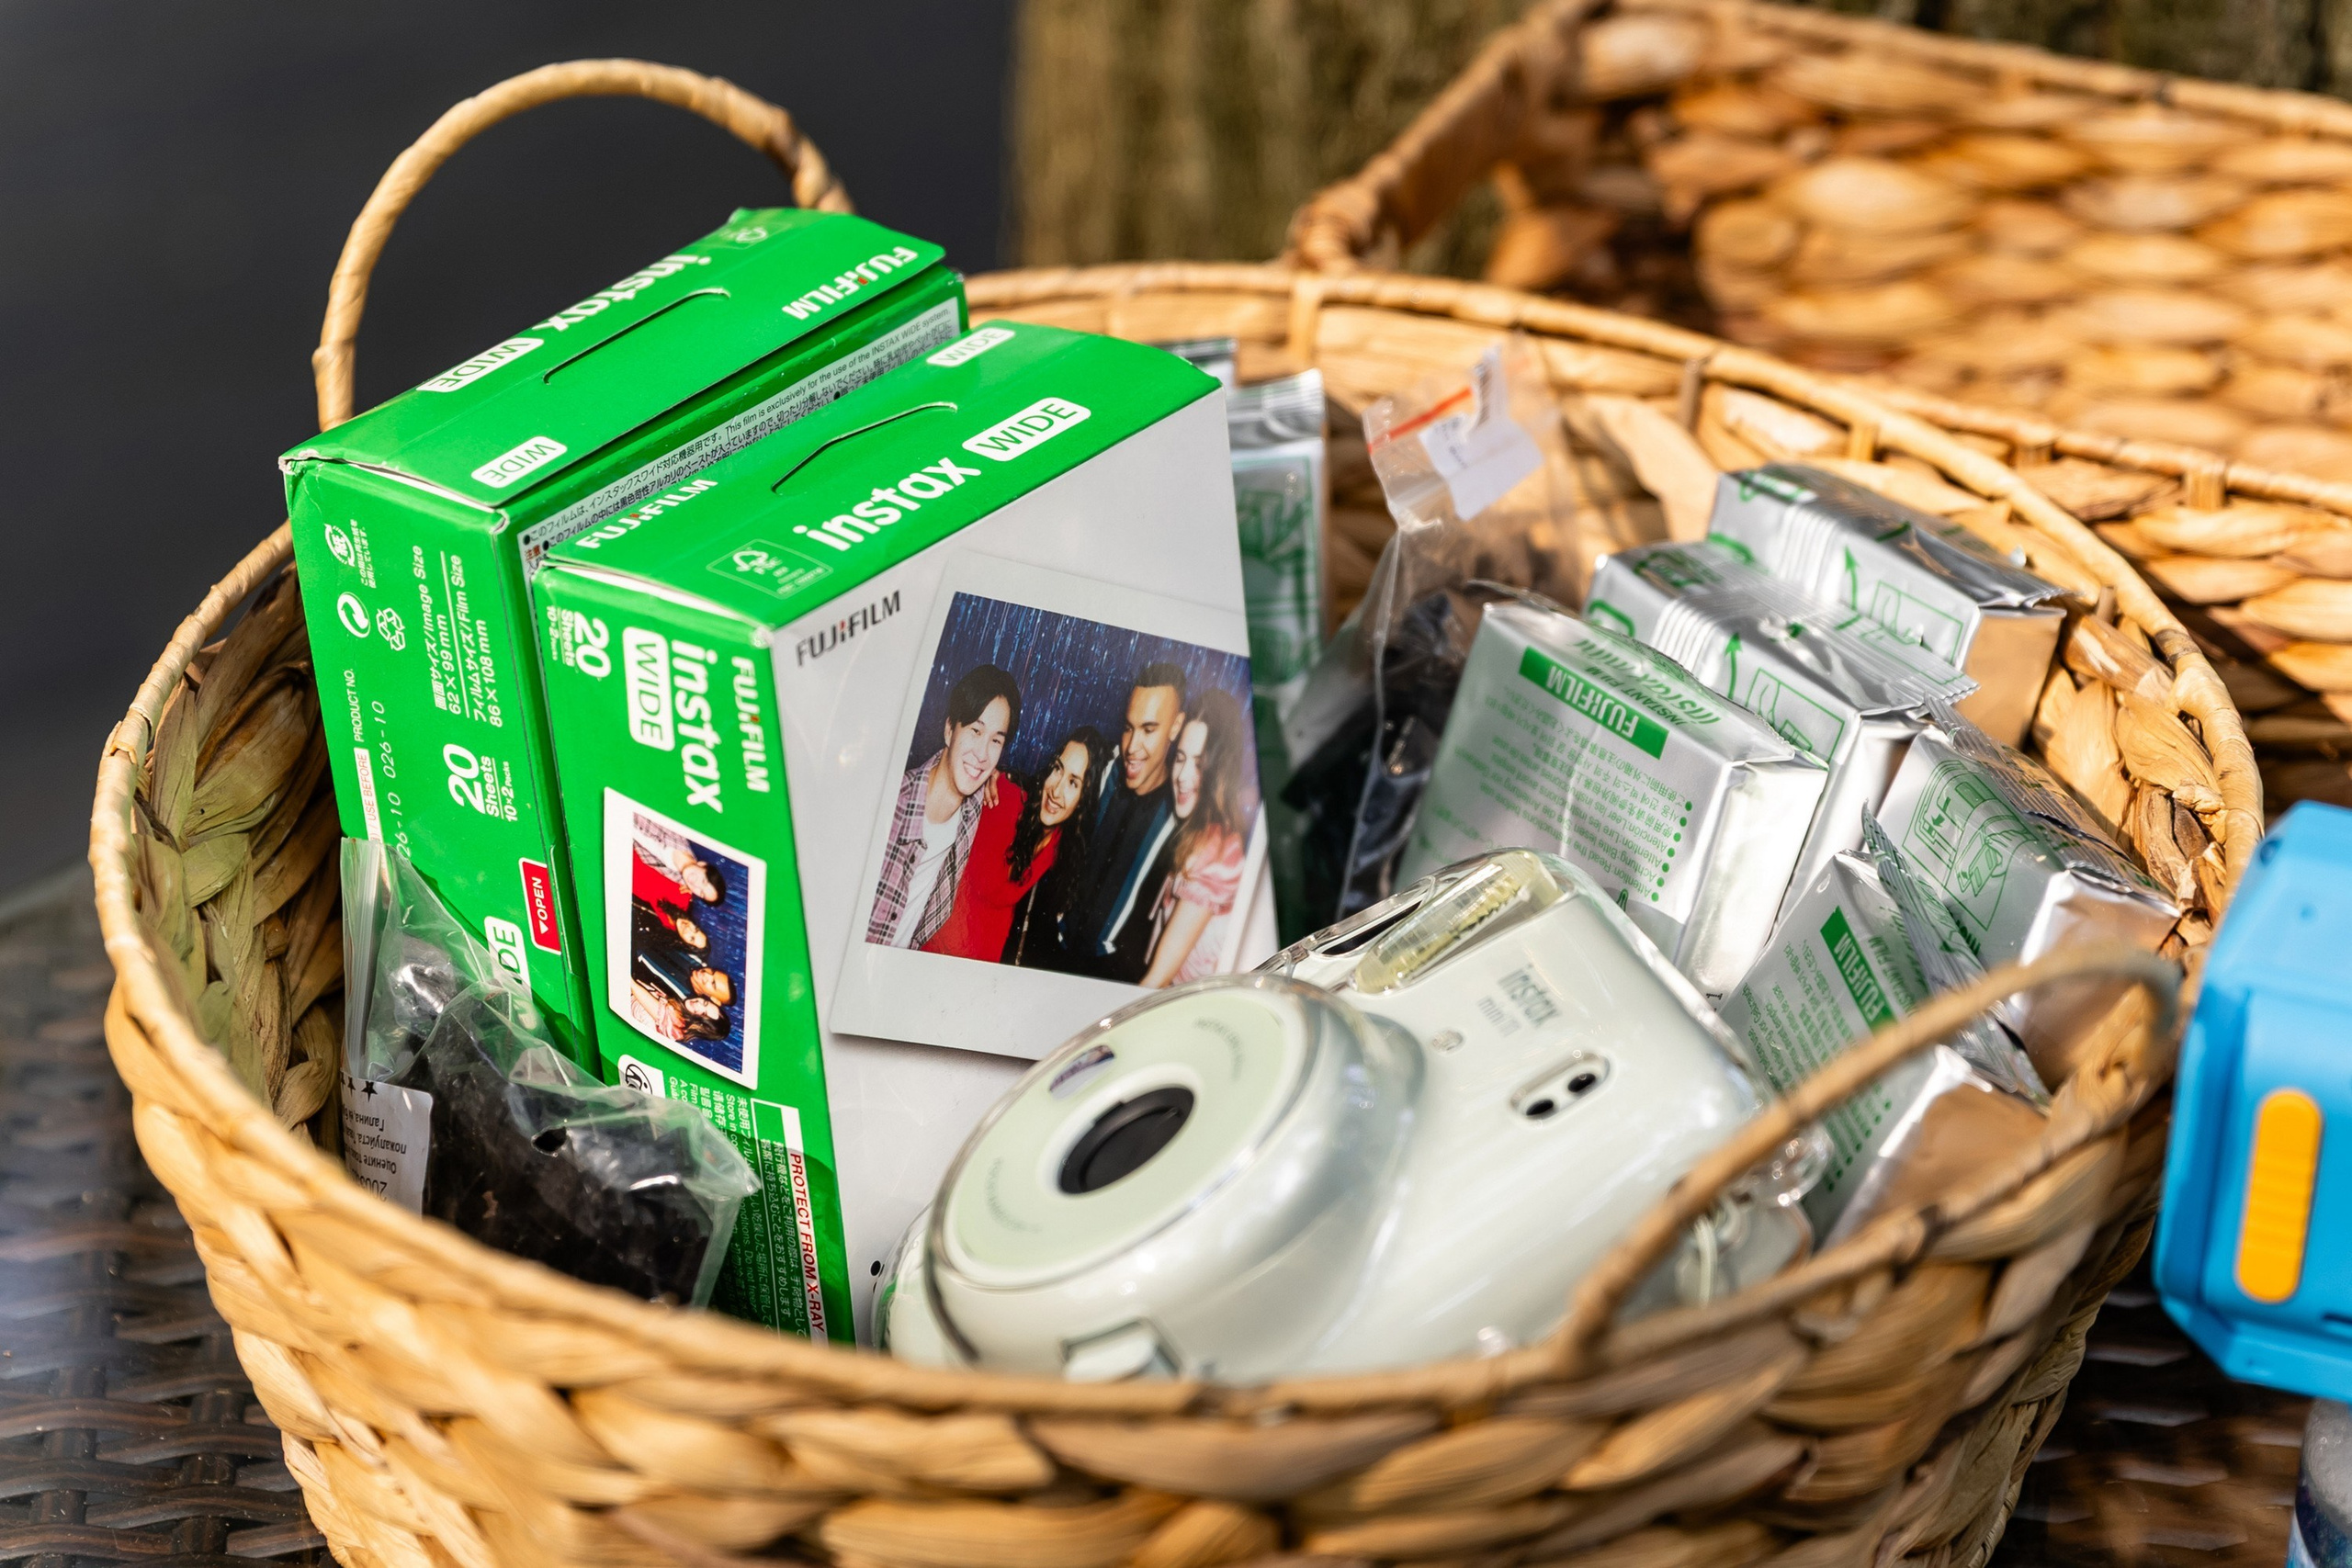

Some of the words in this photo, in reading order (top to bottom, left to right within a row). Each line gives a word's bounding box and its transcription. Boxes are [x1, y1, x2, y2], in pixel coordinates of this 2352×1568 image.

[533, 254, 711, 331] instax
[782, 246, 918, 321] FUJIFILM
[430, 339, 530, 389] WIDE
[943, 328, 1004, 365] WIDE
[741, 412, 757, 425] film
[757, 408, 765, 417] is
[765, 385, 806, 412] exclusively
[807, 378, 817, 389] for
[818, 371, 831, 383] the
[831, 362, 847, 376] use
[846, 356, 857, 368] of
[856, 351, 870, 363] the
[870, 334, 899, 355] INSTAX
[899, 322, 921, 340] WIDE
[487, 441, 558, 482] WIDE
[793, 457, 981, 551] instax
[976, 401, 1078, 453] WIDE
[575, 479, 718, 547] FUJIFILM
[412, 546, 425, 579] Size
[449, 555, 465, 587] Size
[435, 614, 449, 647] mm
[475, 619, 490, 652] mm
[561, 609, 575, 667] Sheets
[574, 612, 612, 678] 20
[795, 590, 902, 667] FUJIFILM
[343, 668, 355, 687] NO.
[440, 649, 454, 671] 99
[481, 657, 495, 682] 108
[1583, 664, 1623, 688] FILM
[447, 691, 461, 714] 62
[635, 643, 663, 741] WIDE
[1544, 664, 1639, 738] FUJIFILM
[1620, 684, 1686, 726] INSTANT
[346, 688, 364, 742] PRODUCT
[488, 705, 503, 727] 86
[672, 640, 723, 813] instax
[731, 656, 770, 792] FUJIFILM
[356, 753, 373, 796] BEFORE
[443, 743, 485, 814] 20
[481, 755, 498, 817] Sheets
[364, 799, 377, 821] USE
[1586, 814, 1603, 829] les
[1592, 800, 1608, 815] las
[1570, 840, 1589, 856] the
[532, 876, 548, 919] OPEN
[1868, 935, 1893, 965] FILM
[1834, 932, 1884, 1021] FUJIFILM
[689, 1083, 699, 1103] Film
[725, 1094, 736, 1120] Store
[729, 1122, 736, 1131] in
[364, 1155, 396, 1174] Оцените
[789, 1153, 809, 1229] PROTECT
[744, 1250, 752, 1263] Do
[800, 1233, 815, 1280] FROM
[806, 1283, 823, 1332] X-RAY
